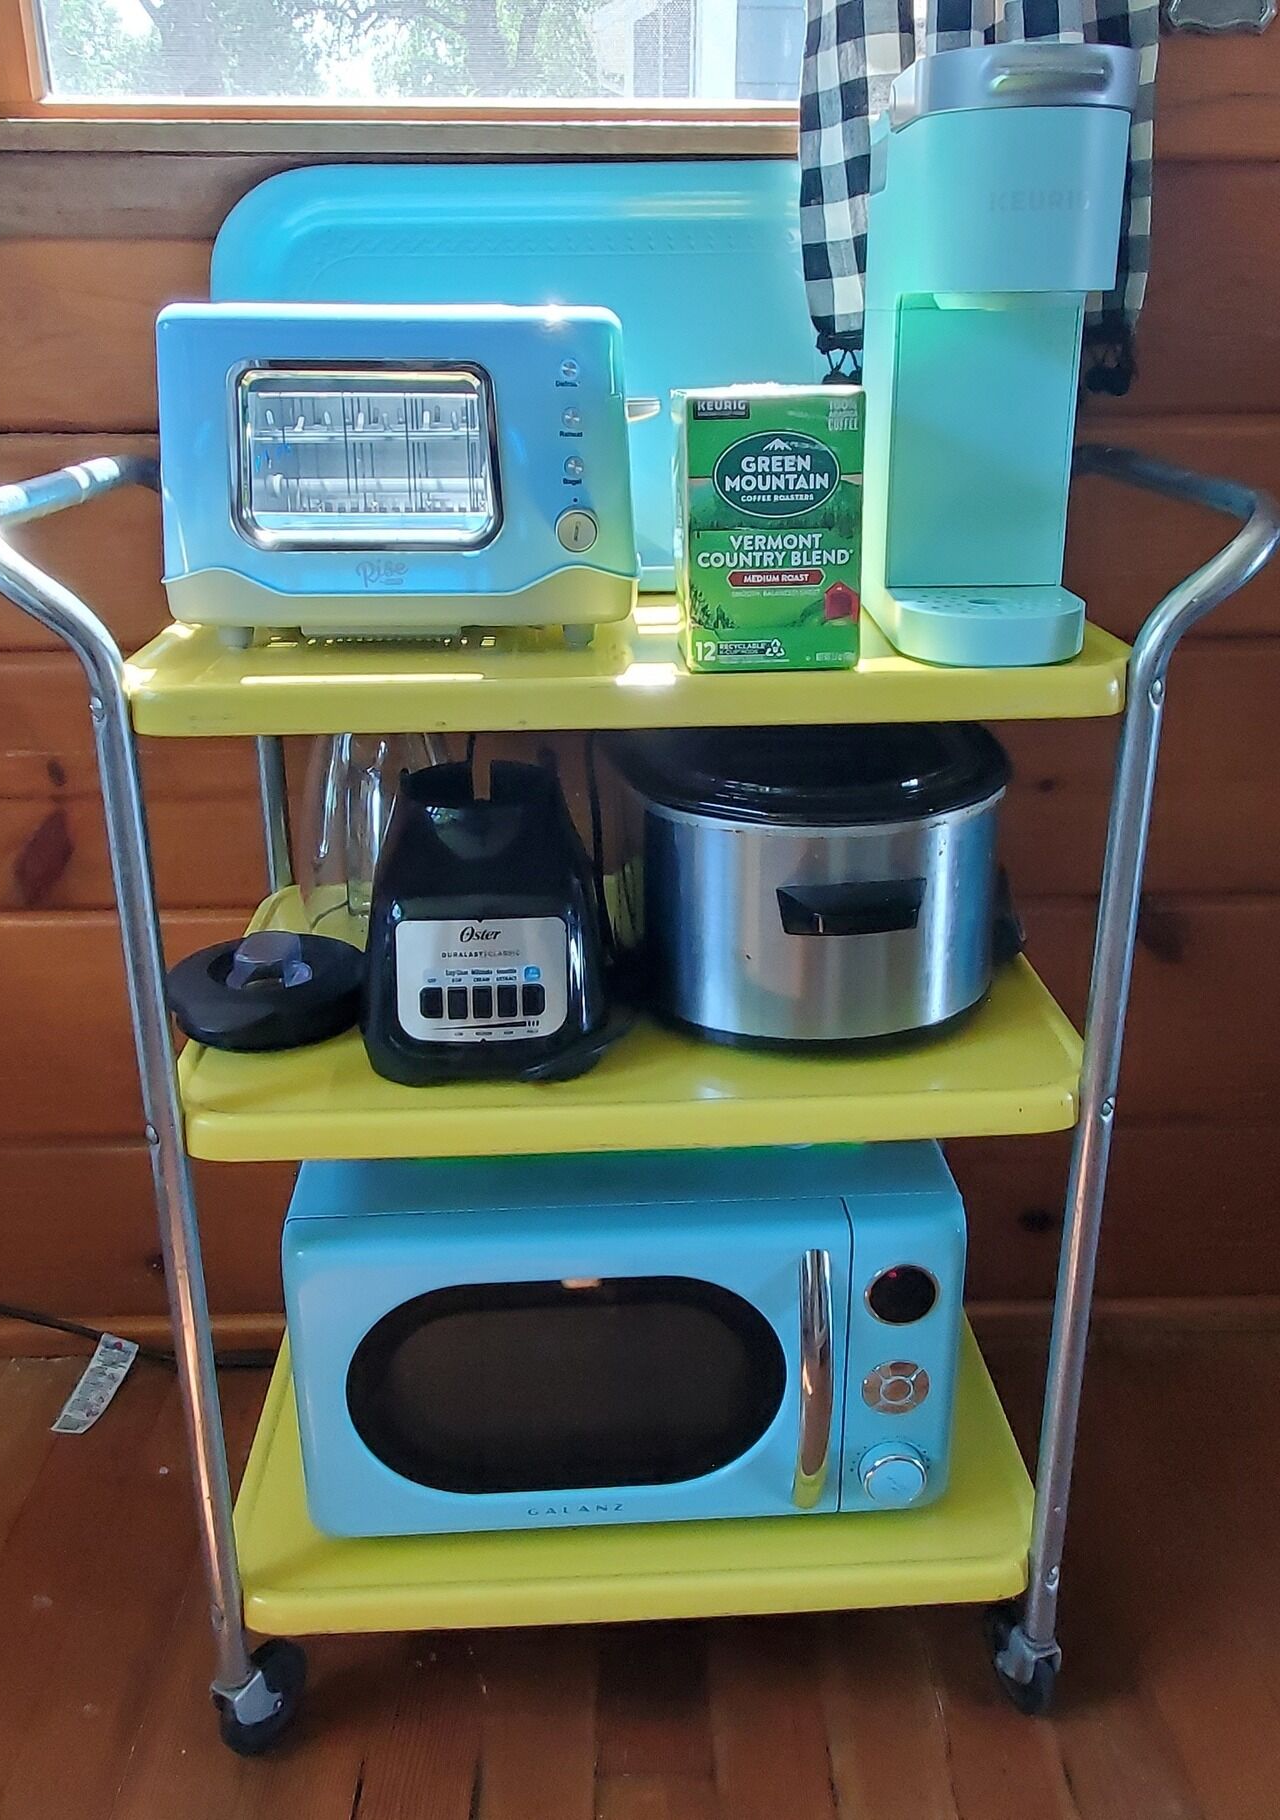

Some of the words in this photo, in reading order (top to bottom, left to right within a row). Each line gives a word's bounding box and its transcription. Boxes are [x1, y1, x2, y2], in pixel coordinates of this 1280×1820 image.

[697, 399, 747, 411] KEURIG
[741, 454, 811, 473] GREEN
[725, 472, 829, 492] MOUNTAIN
[740, 494, 772, 502] COFFEE
[773, 493, 814, 502] ROASTERS
[729, 533, 823, 550] VERMONT
[697, 551, 787, 568] COUNTRY
[791, 549, 850, 566] BLEND
[743, 574, 780, 583] MEDIUM
[781, 573, 809, 582] ROAST
[695, 641, 716, 661] 12
[460, 926, 501, 943] Oster
[528, 1503, 623, 1515] GALANZ
